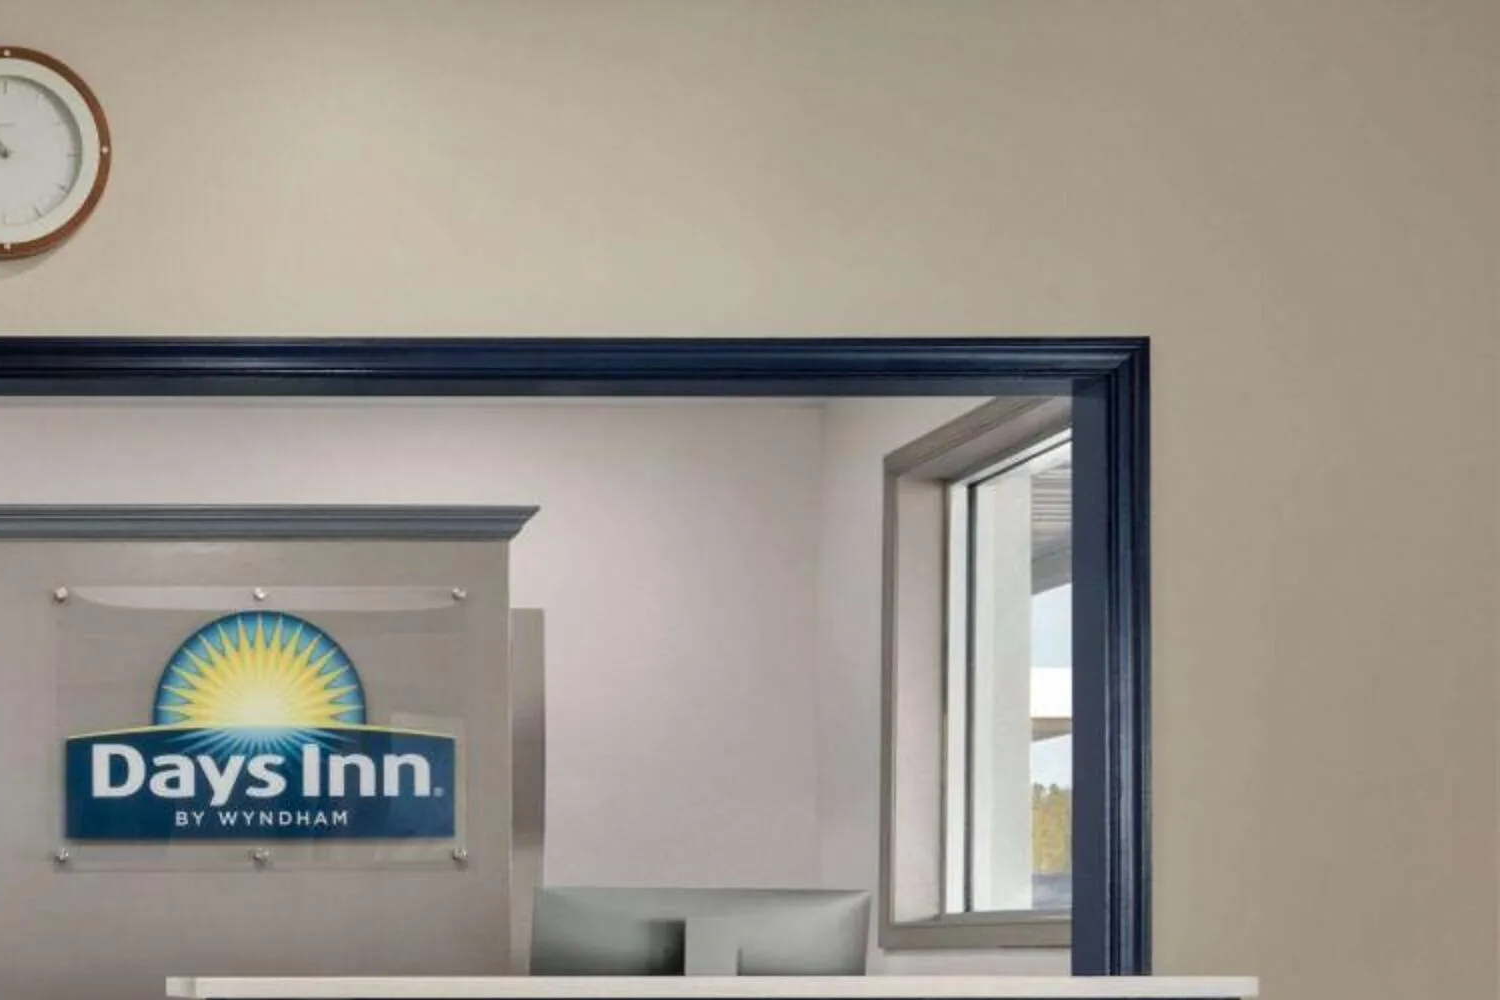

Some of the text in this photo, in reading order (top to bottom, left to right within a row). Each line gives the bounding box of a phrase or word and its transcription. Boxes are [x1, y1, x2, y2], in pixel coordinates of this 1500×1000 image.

[91, 743, 432, 807] Days Inn
[175, 811, 349, 827] BY WYNDHAM
